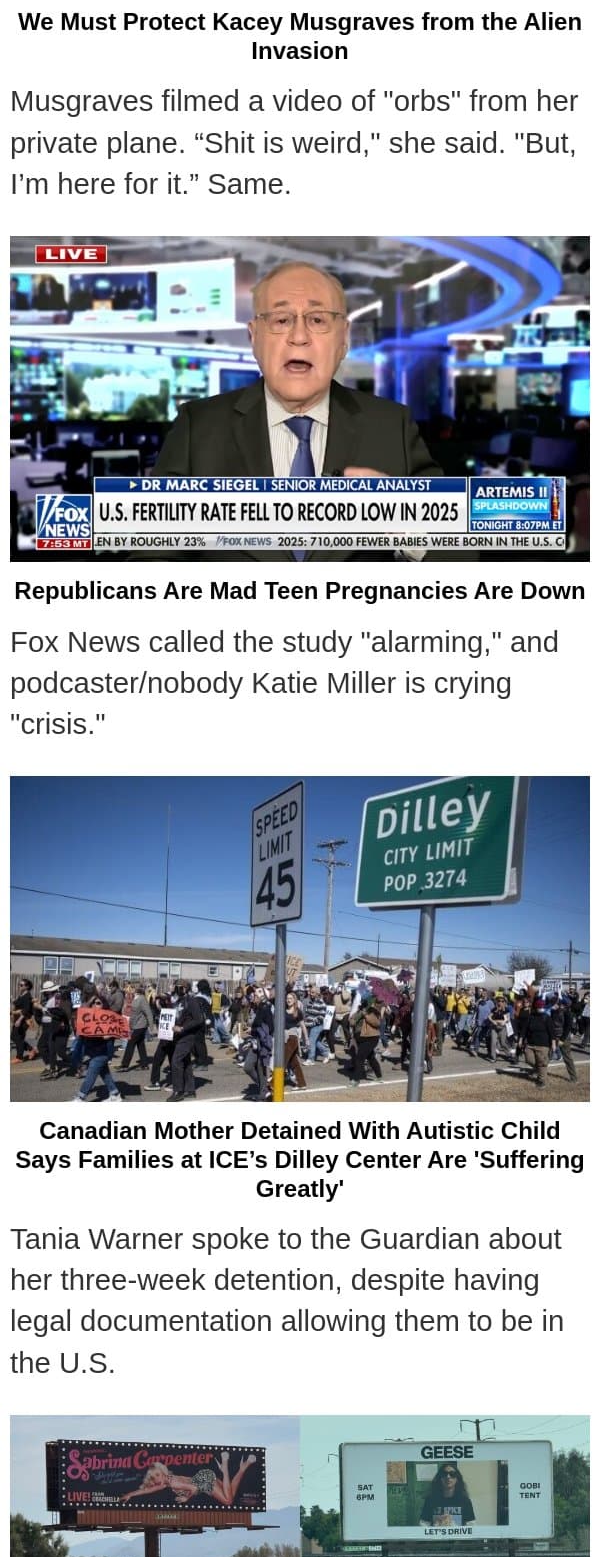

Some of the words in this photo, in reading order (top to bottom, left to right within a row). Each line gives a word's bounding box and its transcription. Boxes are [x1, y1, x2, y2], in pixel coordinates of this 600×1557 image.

[252, 41, 348, 59] Invasion
[45, 248, 98, 259] LIVE
[142, 479, 161, 491] DR
[165, 479, 208, 491] MARC
[213, 479, 260, 491] SIEGEL
[271, 479, 316, 491] SENIOR
[320, 479, 374, 491] MEDICAL
[376, 479, 432, 491] ANALYST
[475, 486, 534, 498] ARTEMIS
[539, 486, 548, 498] II
[100, 502, 128, 522] U.S.
[133, 502, 197, 522] FERTILITY
[201, 502, 236, 522] RATE
[241, 502, 269, 522] FELL
[273, 502, 293, 522] TO
[298, 502, 357, 522] RECORD
[361, 502, 396, 522] LOW
[401, 502, 416, 522] IN
[421, 502, 459, 522] 2025
[474, 501, 548, 510] SPLASHDOWN
[54, 507, 89, 522] FOX
[45, 523, 91, 537] NEWS
[472, 521, 513, 530] TONIGHT
[516, 521, 550, 530] 8:07PM
[553, 521, 562, 530] ET
[42, 540, 71, 549] 7:53
[73, 540, 88, 549] MT
[94, 537, 109, 547] EN
[114, 537, 127, 547] BY
[131, 537, 180, 547] ROUGHLY
[184, 537, 206, 547] 23%
[222, 538, 242, 546] FOX
[244, 538, 272, 546] NEWS
[278, 537, 307, 547] 2025:
[311, 537, 353, 547] 710,000
[356, 537, 390, 547] FEWER
[394, 537, 428, 547] BABIES
[431, 537, 460, 547] WERE
[463, 537, 493, 547] BORN
[496, 537, 507, 547] IN
[511, 537, 529, 547] THE
[532, 537, 552, 547] U.S.
[256, 801, 298, 838] SPEED
[376, 791, 491, 839] Dilley
[259, 831, 293, 861] LIMIT
[384, 846, 419, 866] CITY
[426, 838, 475, 860] LIMIT
[256, 859, 295, 910] 45
[384, 875, 417, 892] POP
[425, 868, 467, 889] 3274
[256, 1179, 344, 1203] Greatly'
[421, 1446, 474, 1459] GEESE
[67, 1449, 132, 1481] Sabrina
